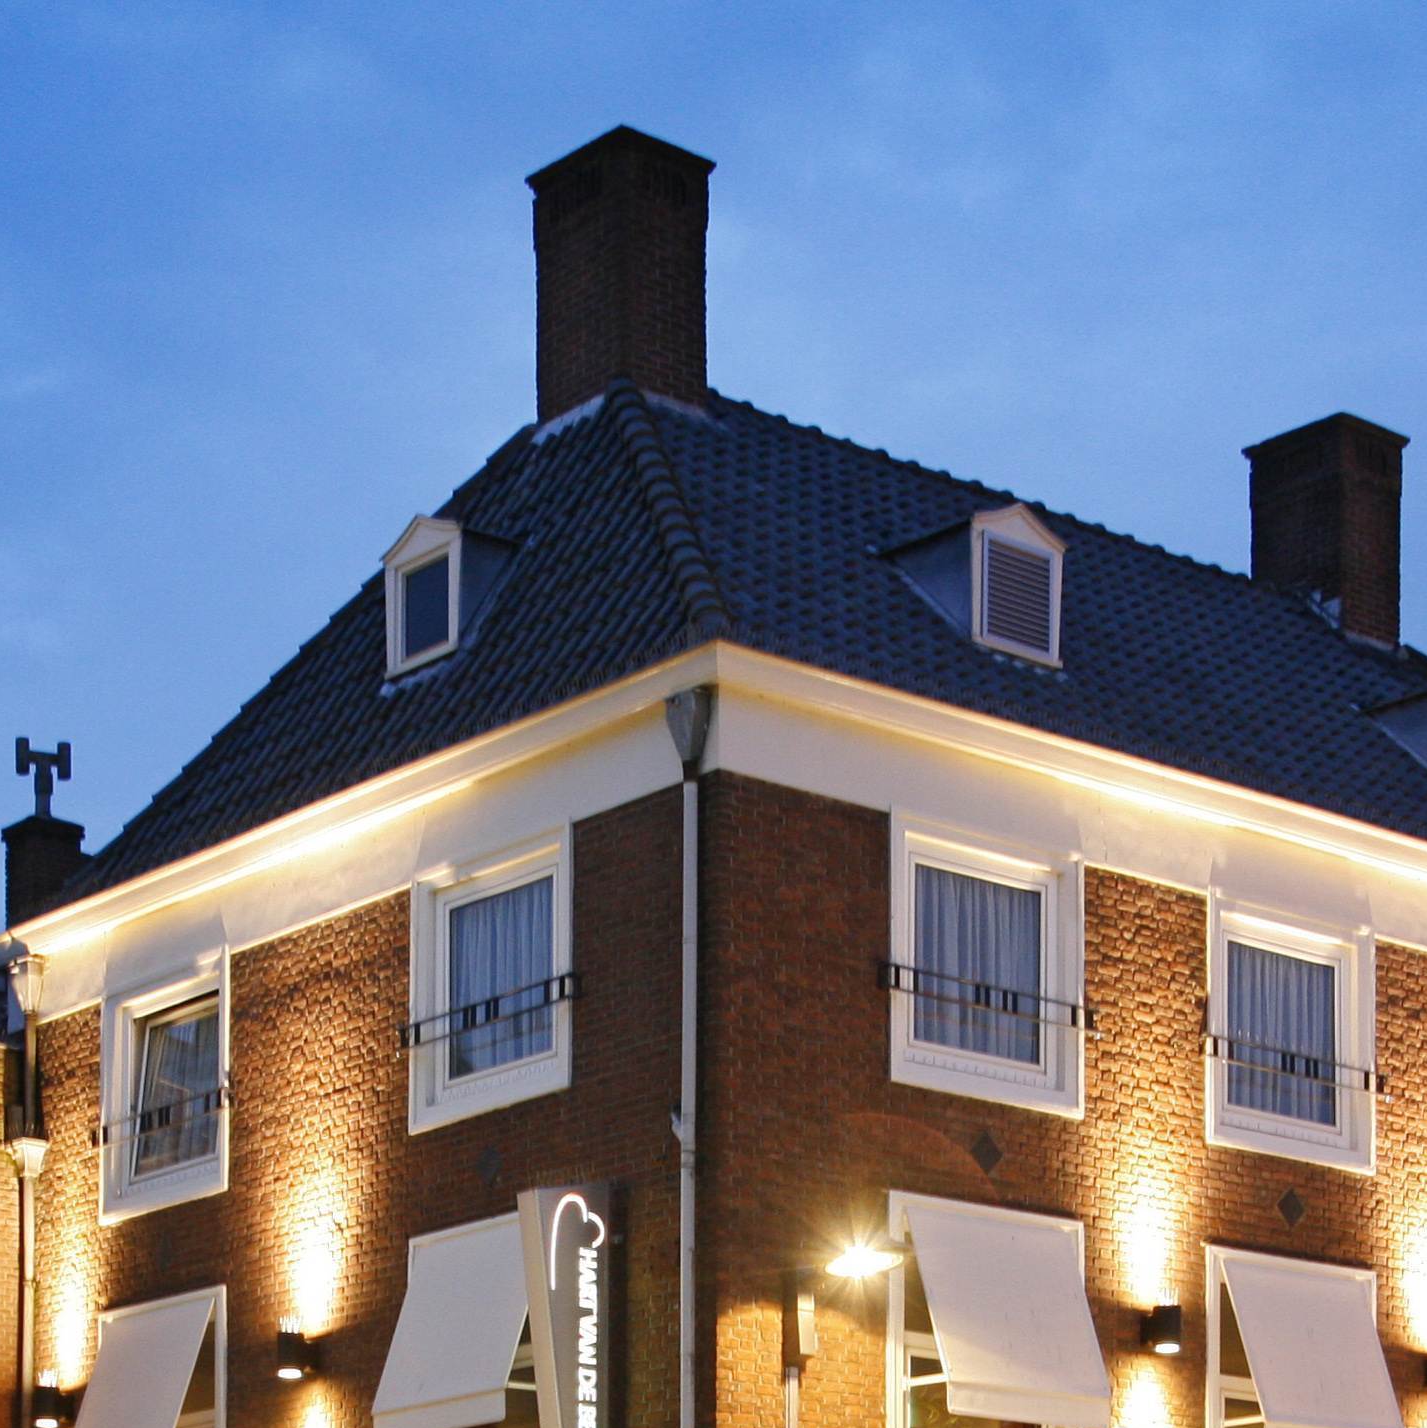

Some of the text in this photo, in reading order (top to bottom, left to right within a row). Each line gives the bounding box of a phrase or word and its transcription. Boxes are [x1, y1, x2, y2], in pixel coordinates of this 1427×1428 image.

[578, 1246, 598, 1315] HART
[578, 1314, 598, 1365] VAN
[578, 1366, 598, 1403] DE
